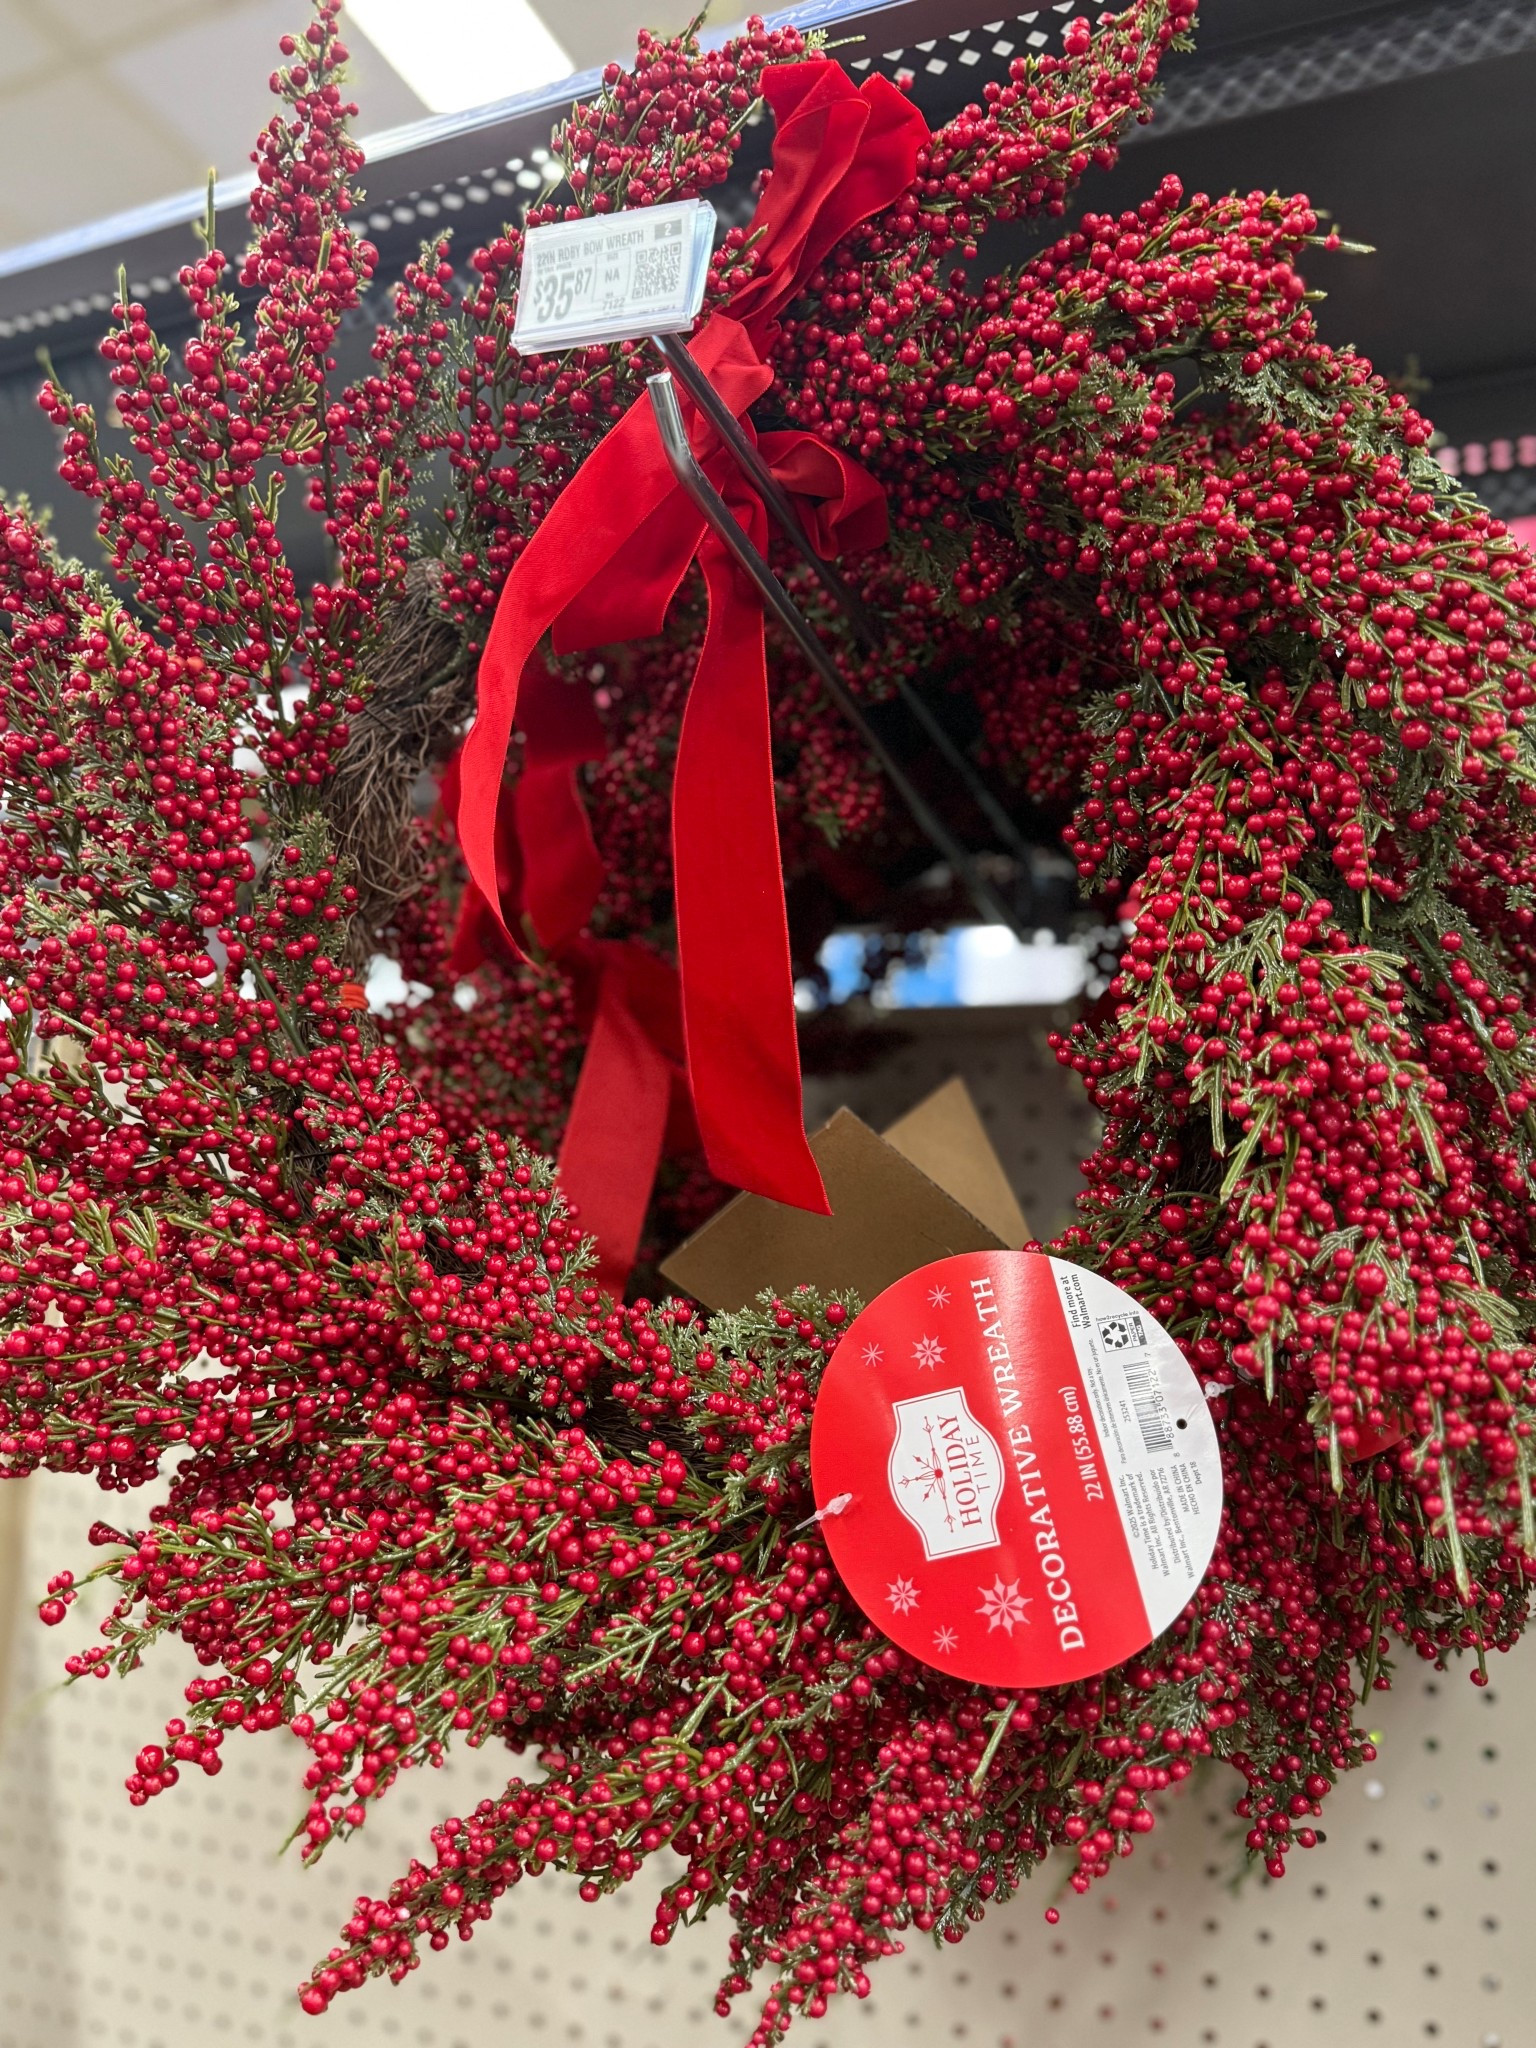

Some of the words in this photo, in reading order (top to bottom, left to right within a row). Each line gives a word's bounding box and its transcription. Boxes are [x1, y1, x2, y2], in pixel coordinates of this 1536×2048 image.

[664, 224, 672, 236] 2
[583, 239, 604, 256] BOW
[606, 230, 645, 250] WREATH
[605, 269, 620, 284] NA
[533, 271, 575, 322] $35
[574, 267, 593, 296] 87
[1060, 1276, 1069, 1284] at
[1064, 1286, 1076, 1308] more
[1071, 1274, 1092, 1329] Walmart.com
[1068, 1309, 1081, 1328] Find
[1096, 1310, 1140, 1322] how2recycle.info
[1129, 1322, 1138, 1342] PAPER
[1136, 1325, 1144, 1337] TAG
[971, 1276, 1024, 1423] WREATH
[1058, 1386, 1079, 1412] cm)
[1095, 1399, 1106, 1422] decoration
[1119, 1400, 1131, 1422] 253241
[1159, 1406, 1175, 1439] 88733
[1066, 1415, 1095, 1460] (55.88
[938, 1414, 983, 1528] HOLIDAY
[964, 1434, 991, 1494] TIME
[1079, 1463, 1098, 1480] IN
[1149, 1469, 1158, 1480] por
[1170, 1464, 1182, 1485] CHINA
[1179, 1463, 1191, 1483] CHINA
[1189, 1461, 1197, 1469] 18
[1157, 1467, 1168, 1484] 72716
[1193, 1469, 1202, 1485] Dept
[1084, 1481, 1104, 1501] 22
[1135, 1471, 1149, 1503] Reserved.
[1162, 1485, 1171, 1494] AR
[1176, 1485, 1184, 1493] IN
[1185, 1484, 1194, 1493] EN
[1121, 1488, 1134, 1516] Walmart
[1128, 1481, 1144, 1515] trademark
[1152, 1479, 1171, 1527] by/Distribuido
[1178, 1494, 1190, 1512] MADE
[1188, 1493, 1200, 1515] HECHO
[1145, 1503, 1156, 1524] Rights
[1166, 1494, 1182, 1534] Bentonville,
[1008, 1424, 1086, 1652] DECORATIVE
[1142, 1528, 1151, 1544] Time
[1150, 1525, 1158, 1534] All
[1154, 1535, 1162, 1547] Inc.
[1165, 1527, 1181, 1564] Distributed
[1147, 1545, 1159, 1570] Holiday
[1157, 1548, 1170, 1577] Walmart
[1181, 1550, 1195, 1579] Walmart
